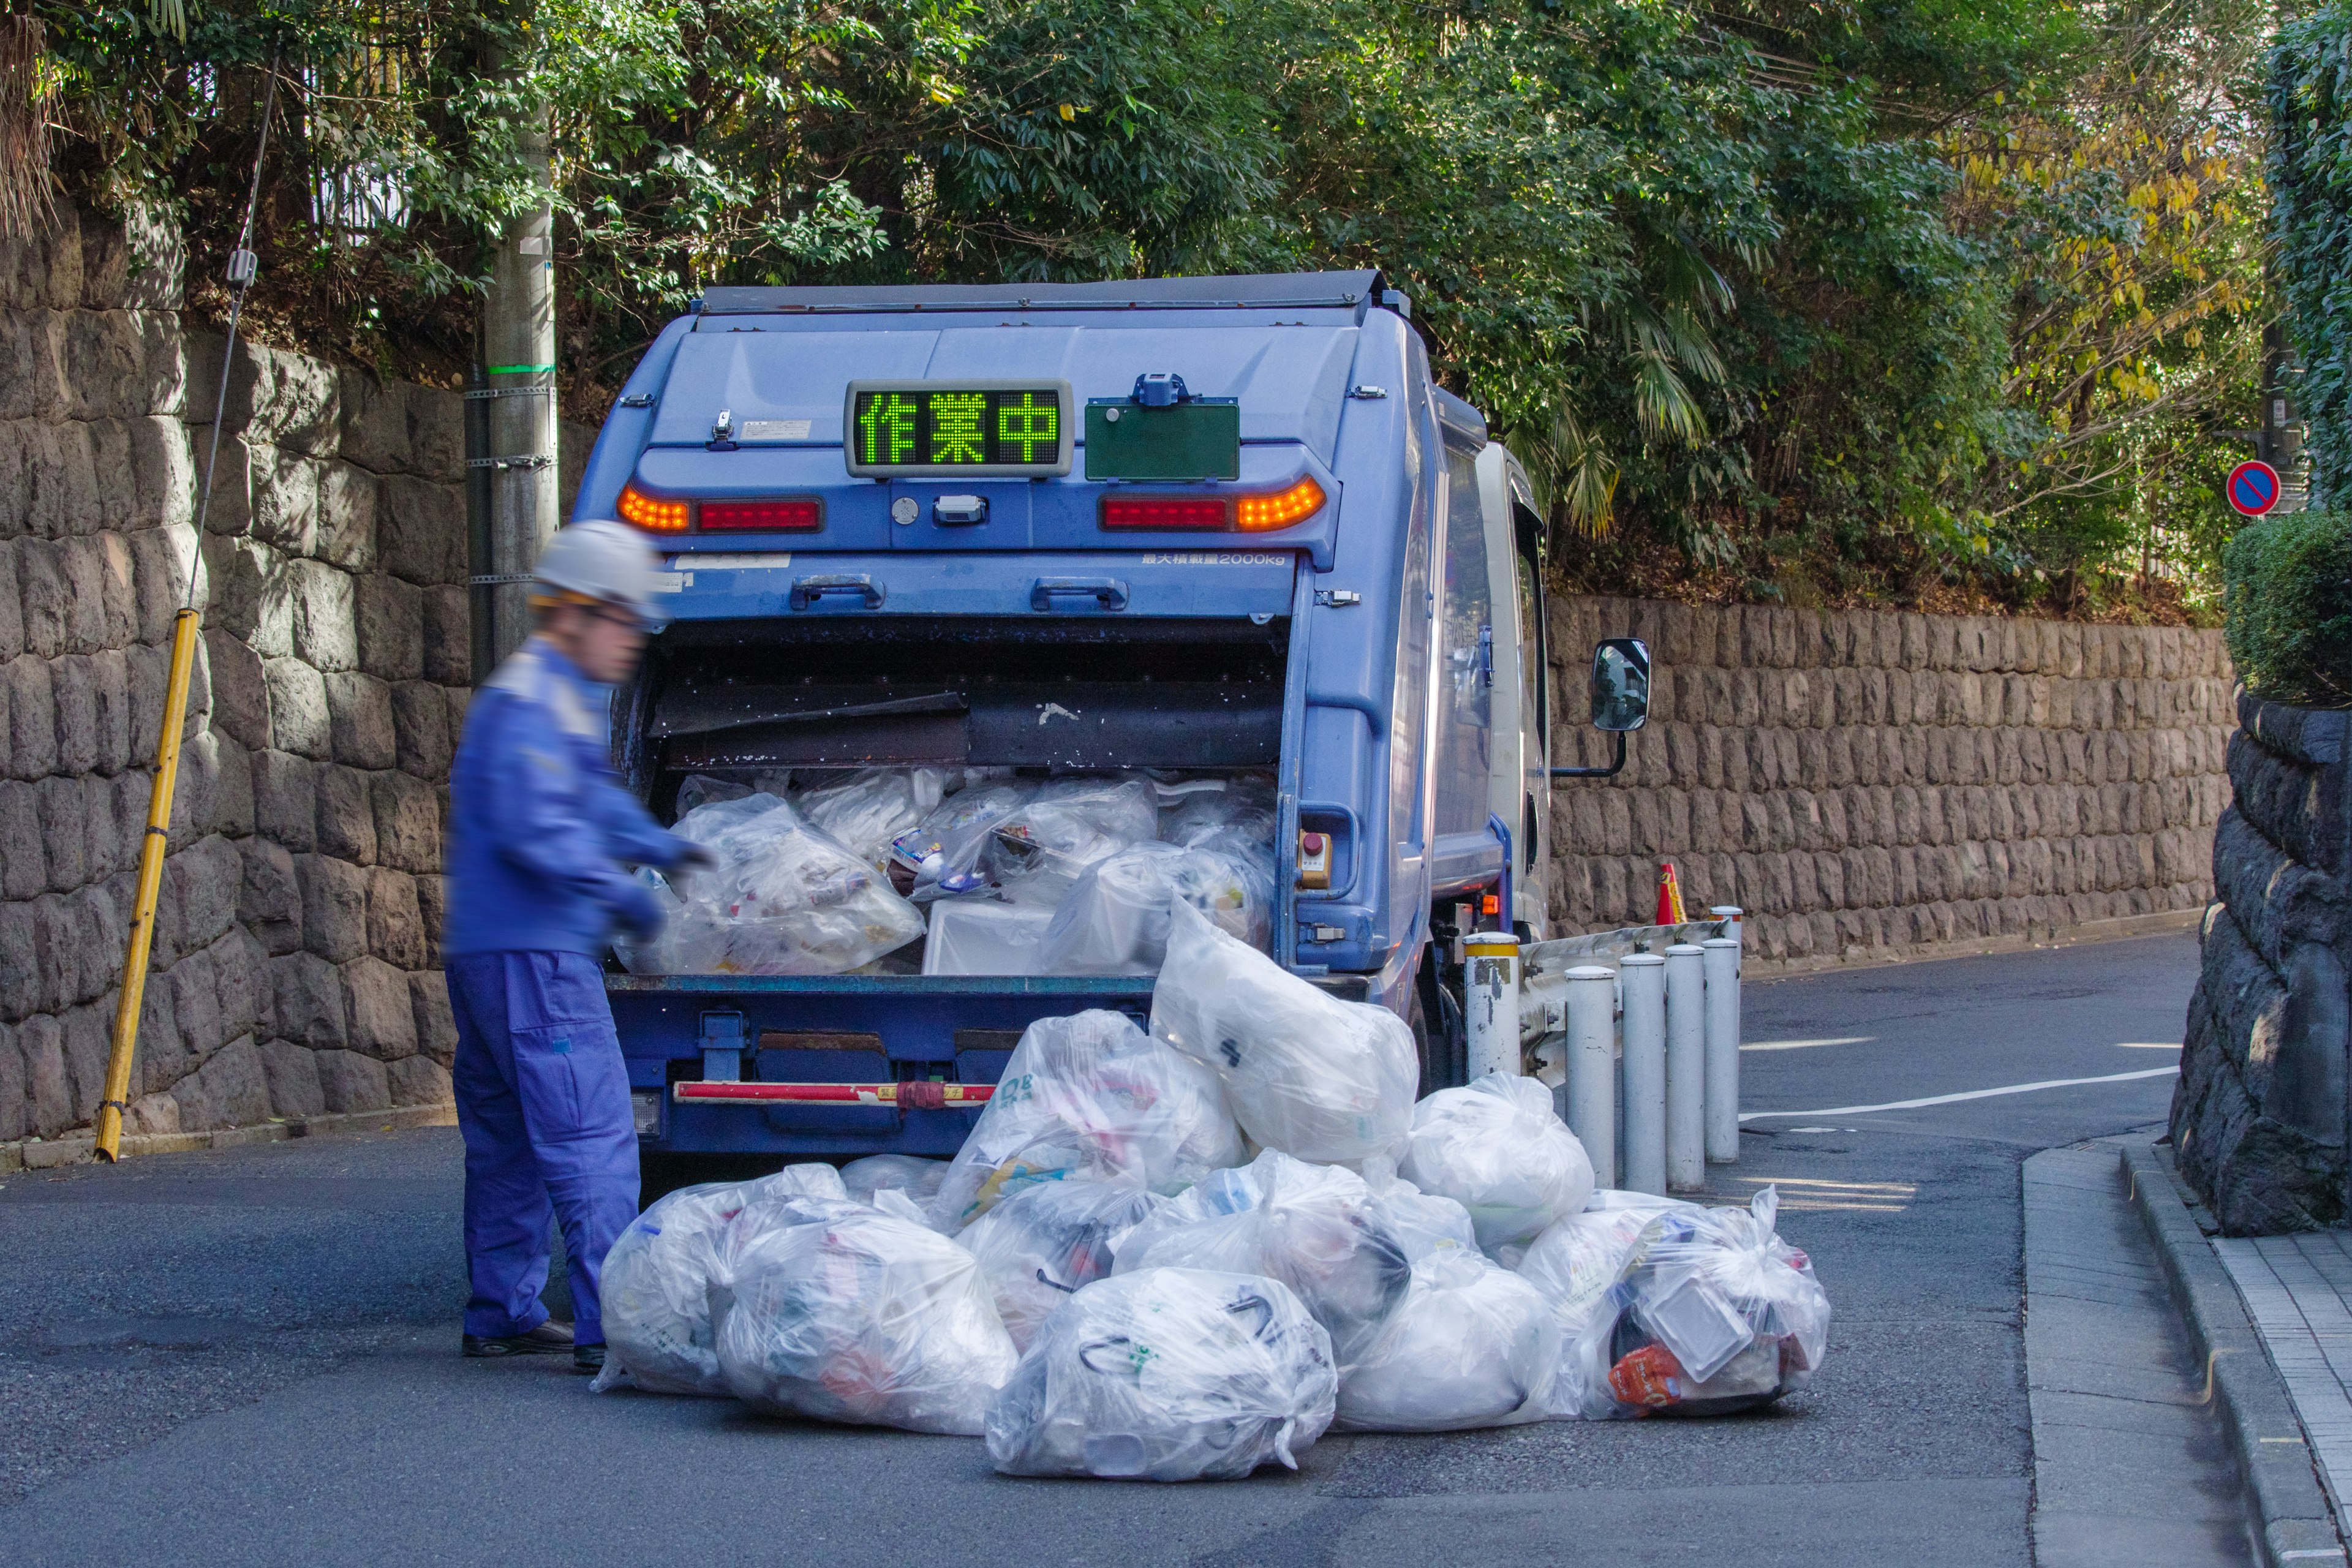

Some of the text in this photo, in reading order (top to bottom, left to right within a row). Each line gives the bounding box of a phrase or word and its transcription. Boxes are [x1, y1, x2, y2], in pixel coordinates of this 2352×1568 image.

[860, 393, 1057, 462] 作業中
[1141, 553, 1285, 566] 最大積載量2000kg
